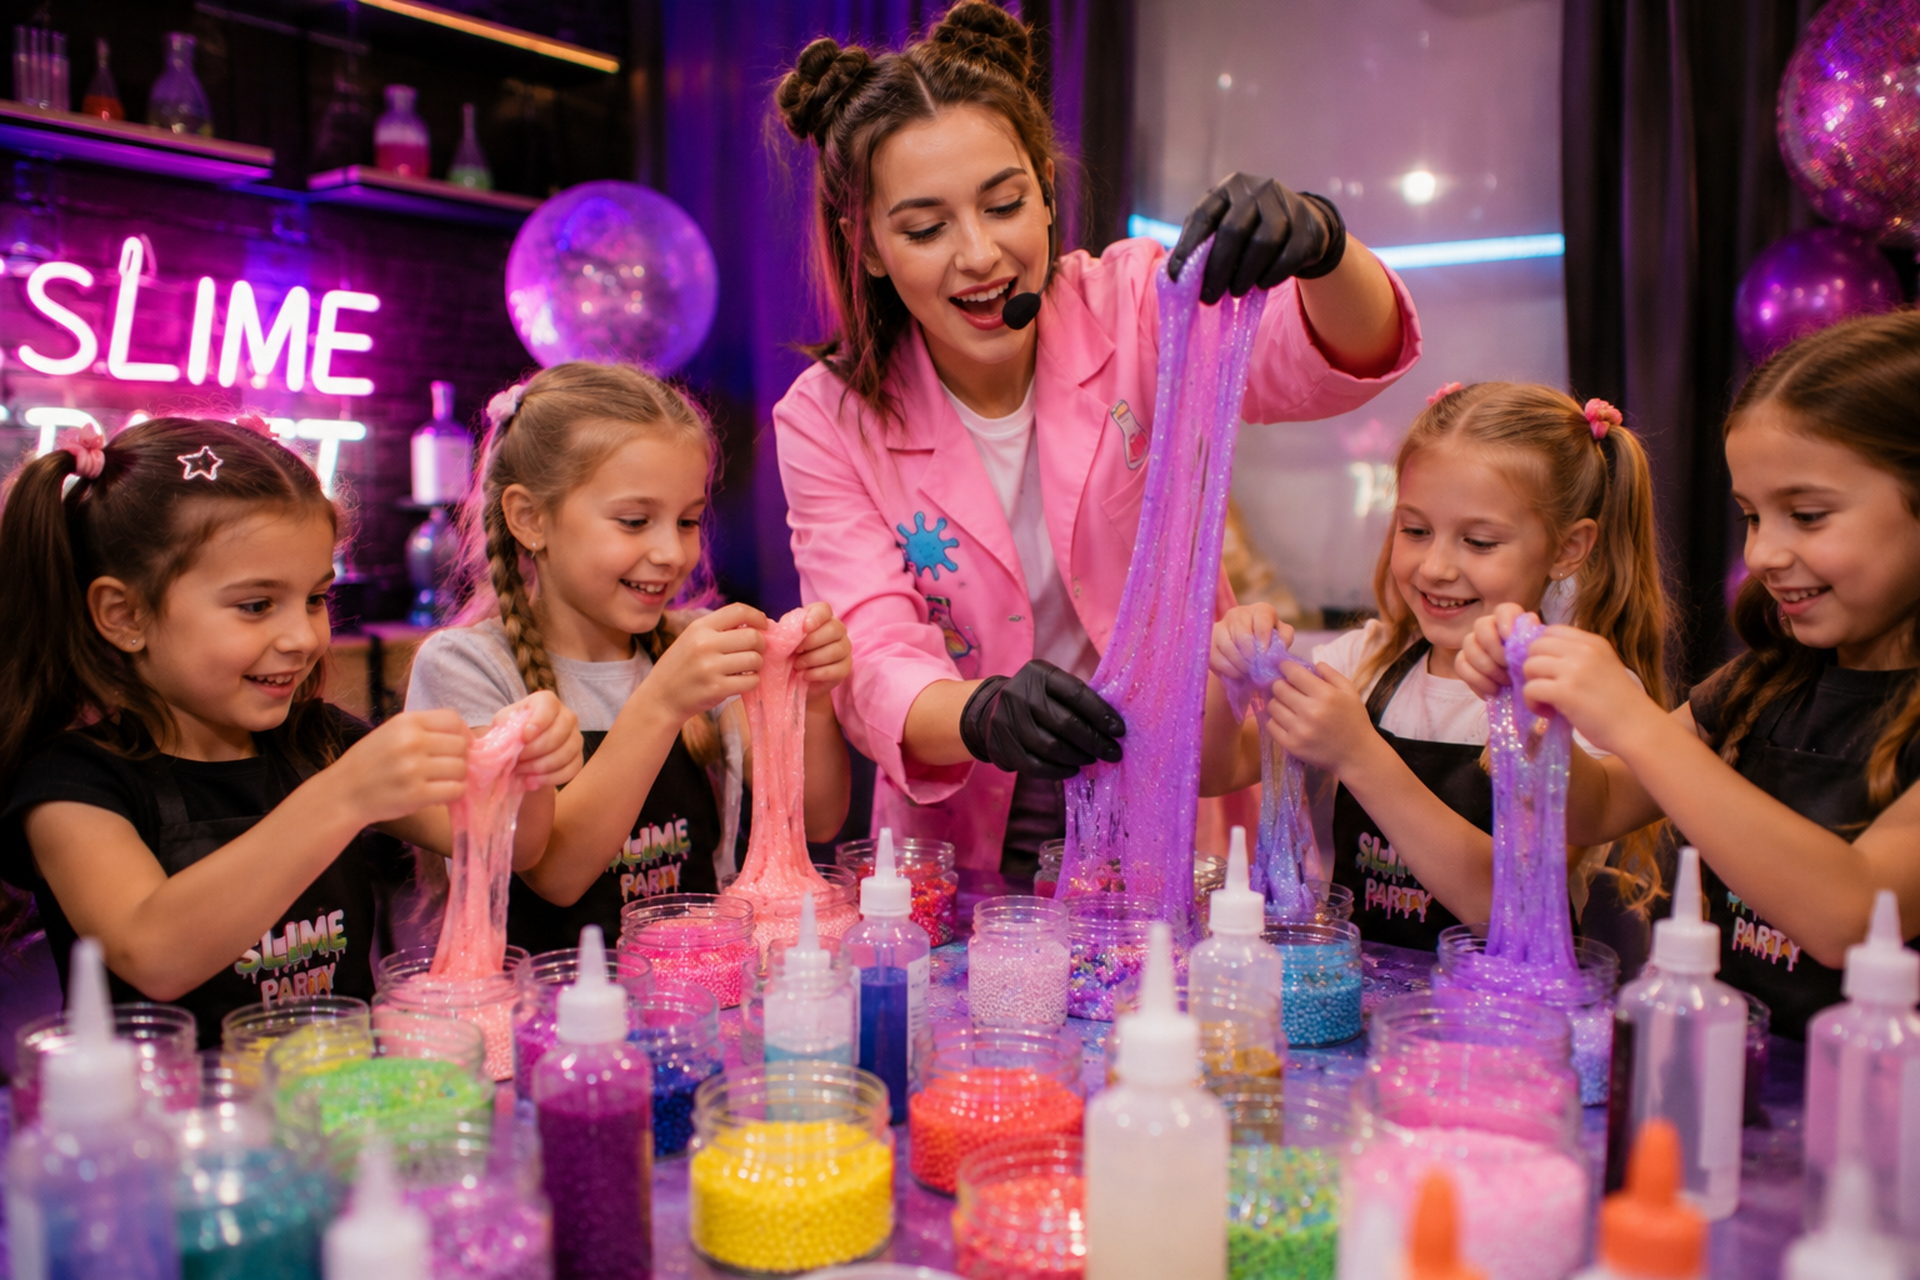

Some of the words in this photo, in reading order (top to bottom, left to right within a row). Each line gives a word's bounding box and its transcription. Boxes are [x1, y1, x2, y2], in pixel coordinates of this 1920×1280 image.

[18, 236, 381, 397] SLIME
[609, 817, 691, 870] LIME
[620, 861, 682, 903] PARTY
[1364, 878, 1433, 923] PARTY
[1732, 916, 1801, 972] PARTY
[260, 961, 336, 1008] PARTY
